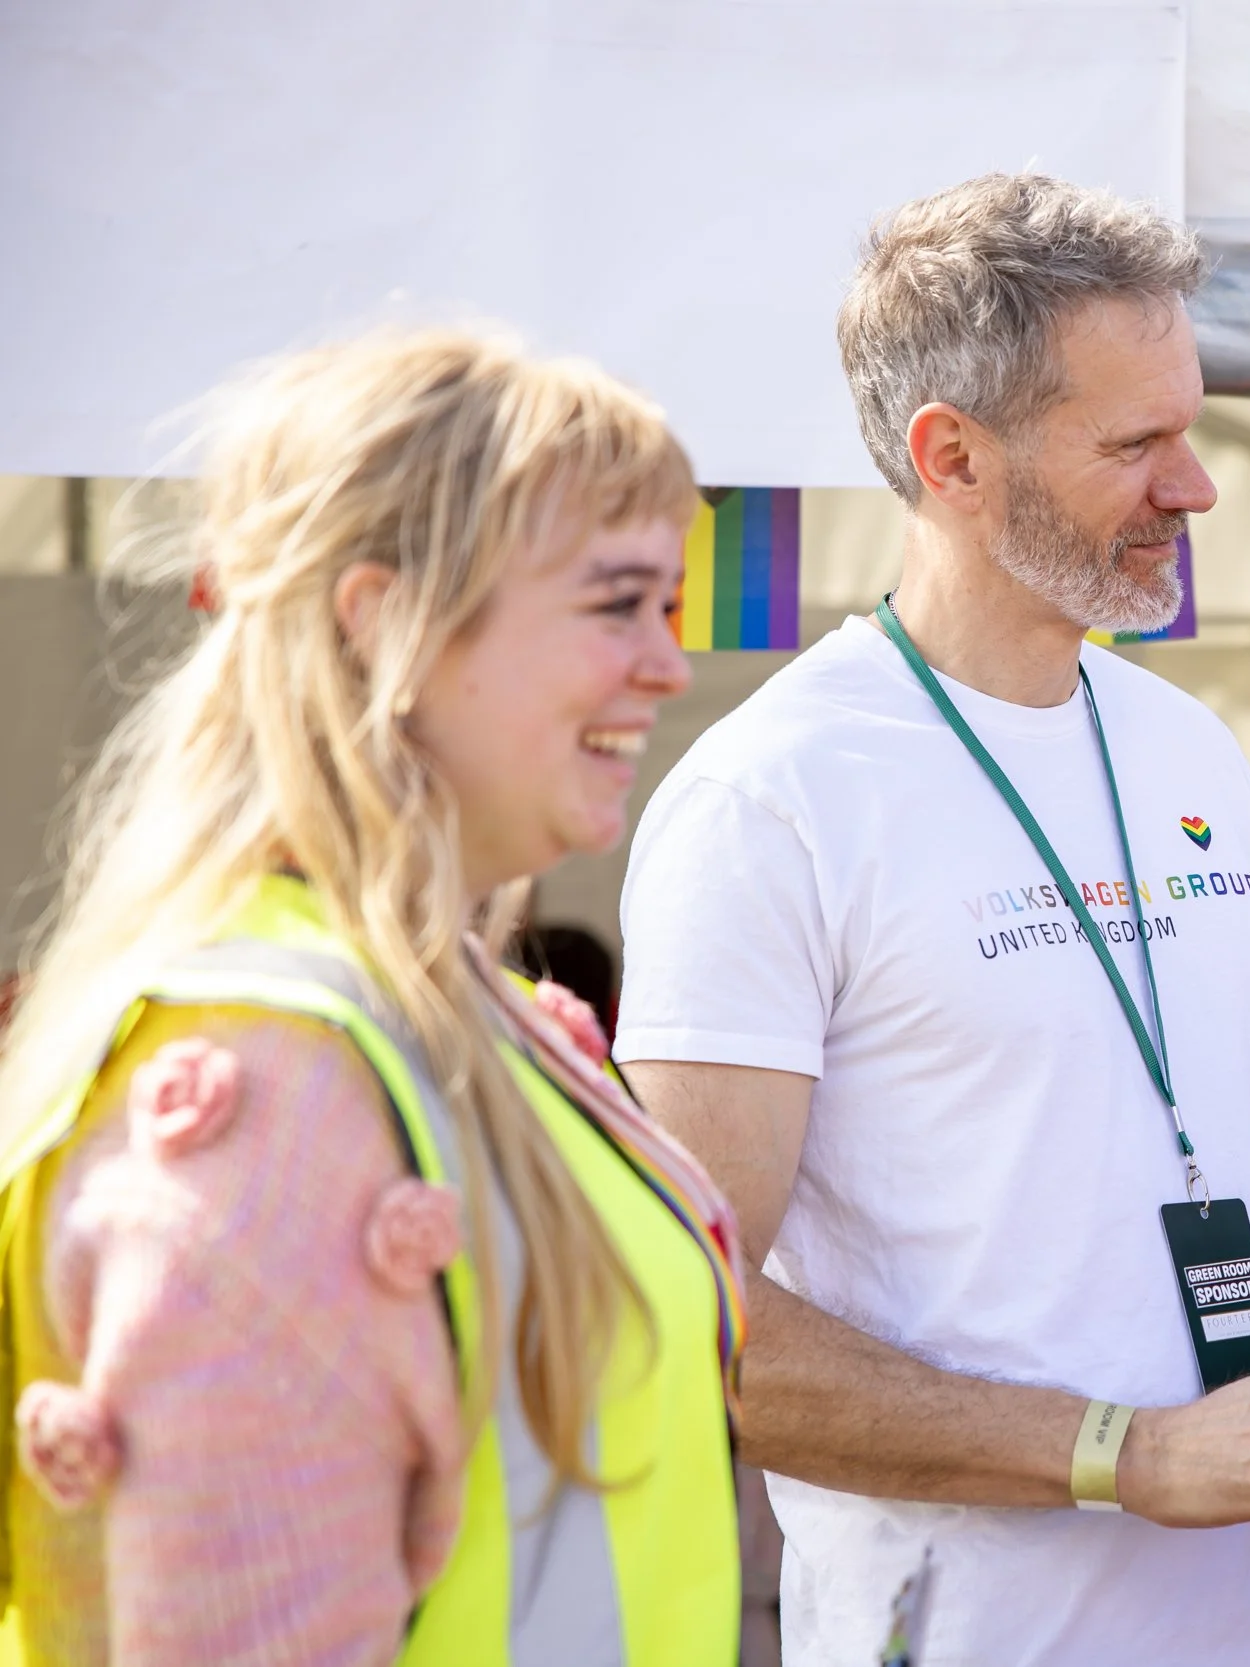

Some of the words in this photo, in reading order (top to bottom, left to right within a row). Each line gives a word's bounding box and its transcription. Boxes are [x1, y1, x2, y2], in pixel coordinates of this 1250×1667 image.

[978, 922, 1067, 959] UNITED
[1071, 916, 1177, 944] KNGDOM
[1188, 1266, 1222, 1283] GREEN
